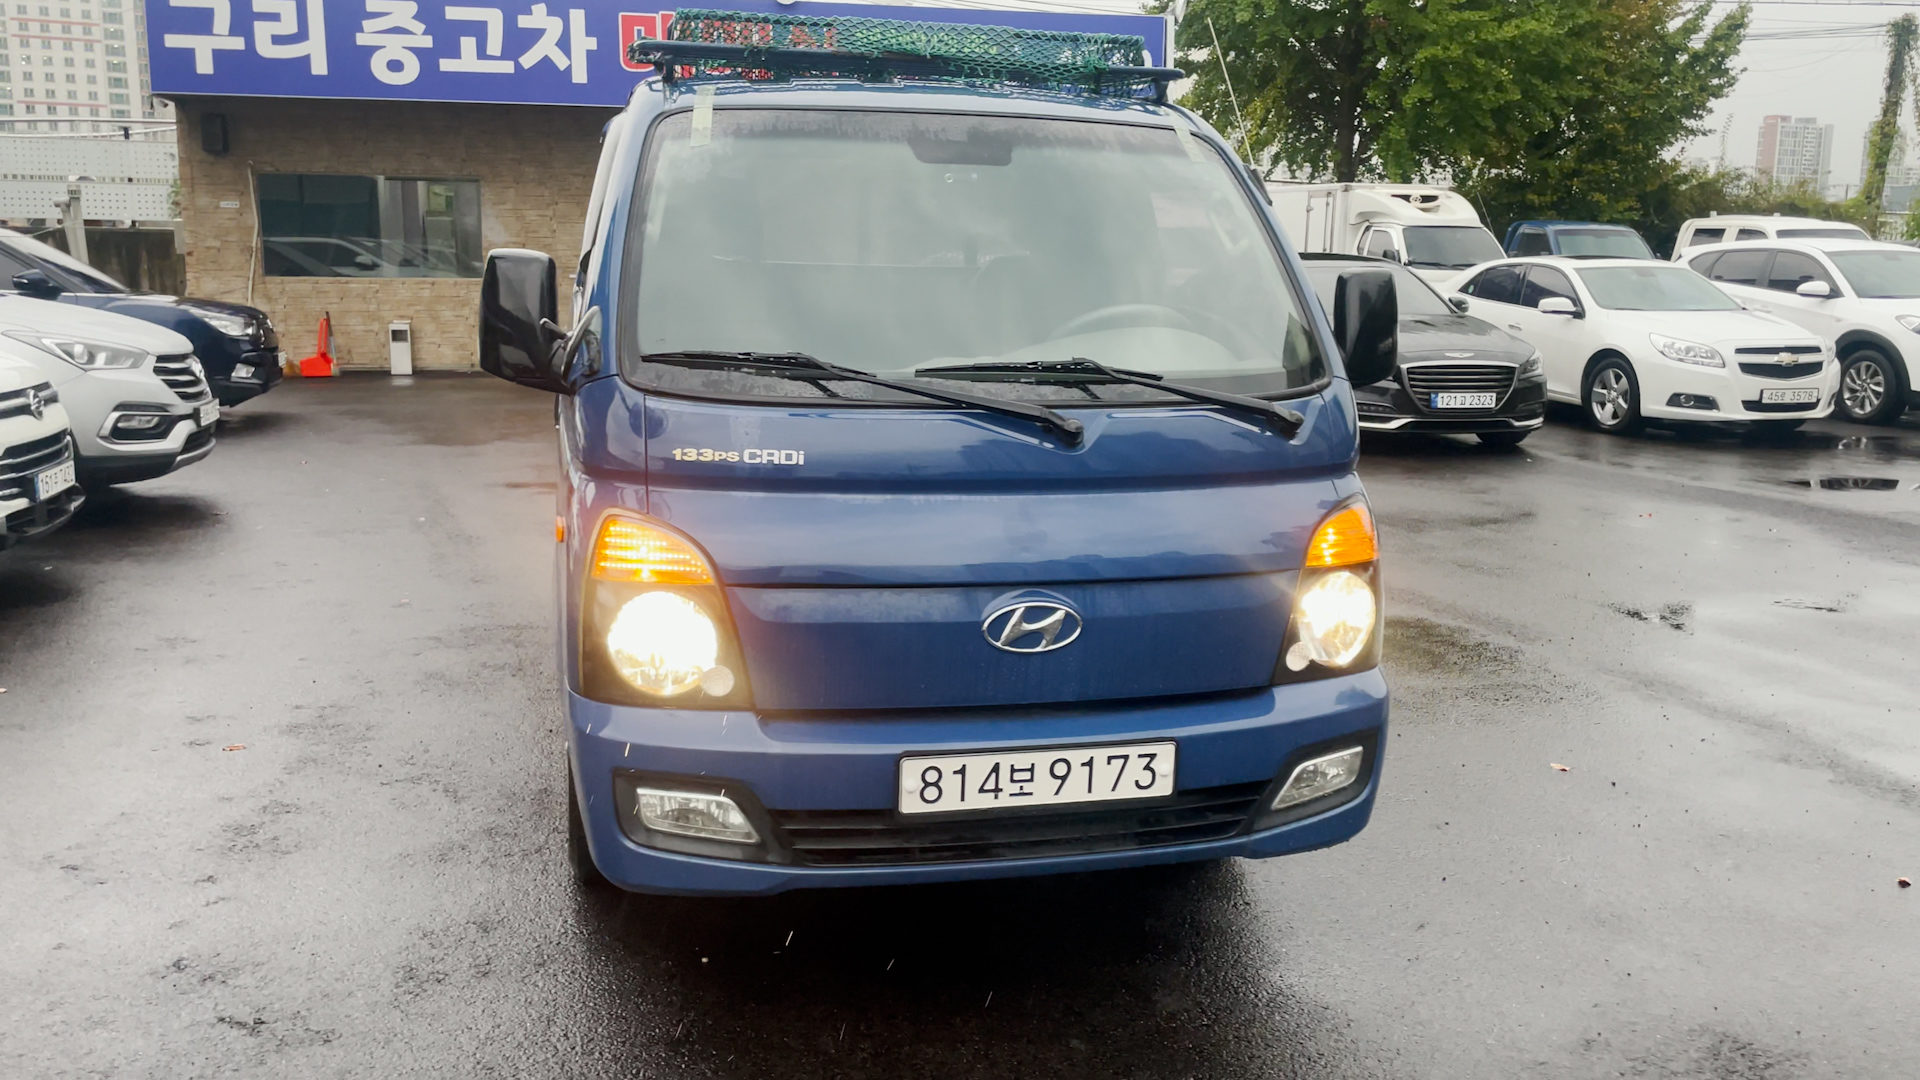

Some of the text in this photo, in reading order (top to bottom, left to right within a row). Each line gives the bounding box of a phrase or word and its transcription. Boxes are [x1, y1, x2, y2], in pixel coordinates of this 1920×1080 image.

[164, 0, 328, 76] 구리
[356, 0, 597, 86] 중고차
[743, 448, 805, 466] CRDi
